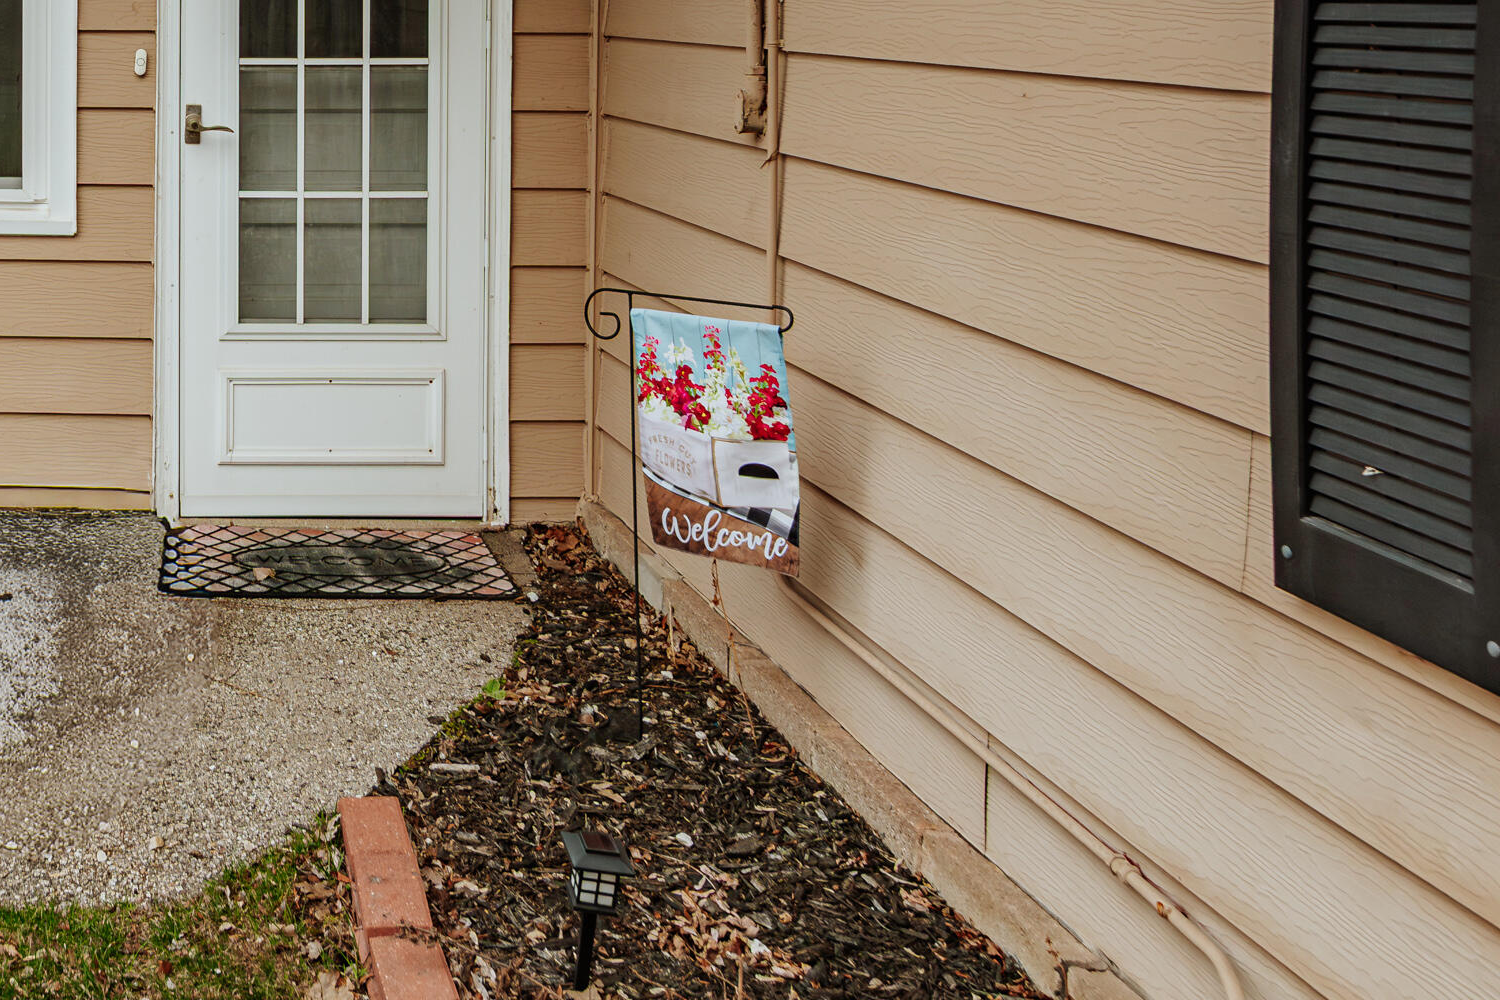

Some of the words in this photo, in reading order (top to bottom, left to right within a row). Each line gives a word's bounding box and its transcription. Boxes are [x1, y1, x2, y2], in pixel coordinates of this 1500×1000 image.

[648, 433, 675, 446] FRESH
[678, 444, 697, 465] CUT
[655, 448, 692, 478] FLOWERS
[661, 507, 789, 561] Welcome
[256, 554, 431, 567] WELCOME
